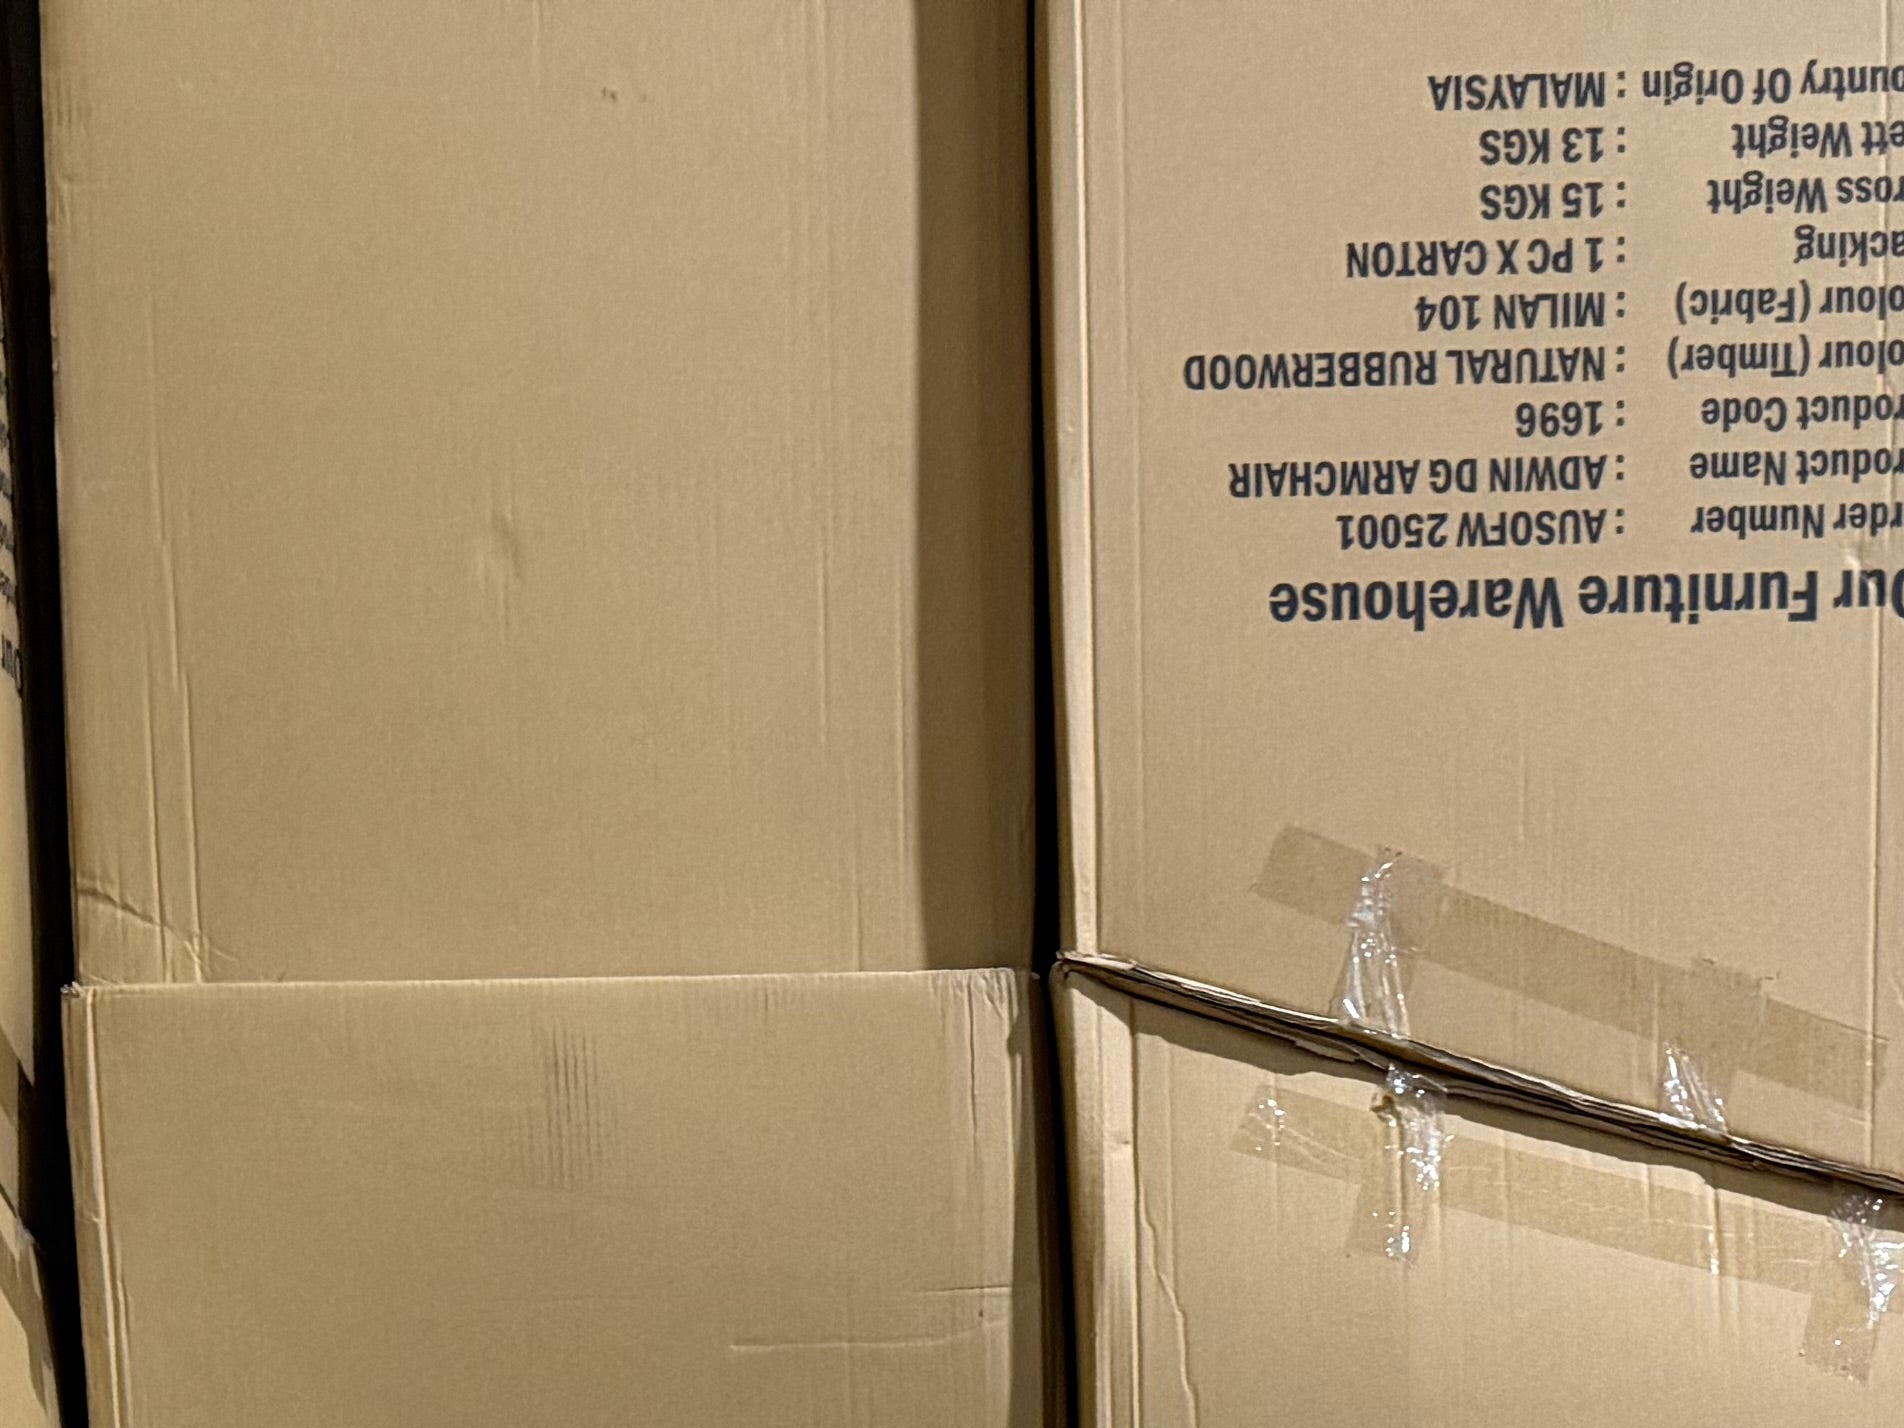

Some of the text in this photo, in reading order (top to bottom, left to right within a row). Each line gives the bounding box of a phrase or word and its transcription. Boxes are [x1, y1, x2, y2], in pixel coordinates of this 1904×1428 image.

[1428, 72, 1605, 111] MALAYSIA
[1643, 62, 1744, 105] Origin
[1752, 68, 1791, 105] Of
[1480, 128, 1549, 165] KGS
[1562, 127, 1603, 163] 13
[1731, 115, 1852, 158] Weight
[1480, 184, 1550, 220] KGS
[1562, 182, 1603, 218] 15
[1707, 170, 1827, 214] Weight
[1347, 240, 1487, 278] CARTON
[1496, 240, 1519, 274] X
[1528, 238, 1573, 274] PC
[1585, 237, 1603, 273] 1
[1415, 295, 1480, 331] 104
[1494, 292, 1605, 329] MILAN
[1676, 279, 1810, 325] (Fabric)
[1184, 351, 1436, 390] RUBBERWOOD
[1446, 347, 1605, 384] NATURAL
[1668, 334, 1810, 379] (Timber)
[1516, 401, 1602, 437] 1696
[1701, 397, 1787, 432] Code
[1228, 459, 1420, 498] ARMCHAIR
[1430, 459, 1477, 494] DG
[1490, 455, 1607, 492] ADWIN
[1690, 451, 1786, 485] Name
[1336, 513, 1448, 550] 25001
[1456, 509, 1607, 547] AUSOFW
[1691, 504, 1824, 540] Number
[1270, 577, 1564, 631] Warehouse
[1579, 571, 1817, 624] Furniture
